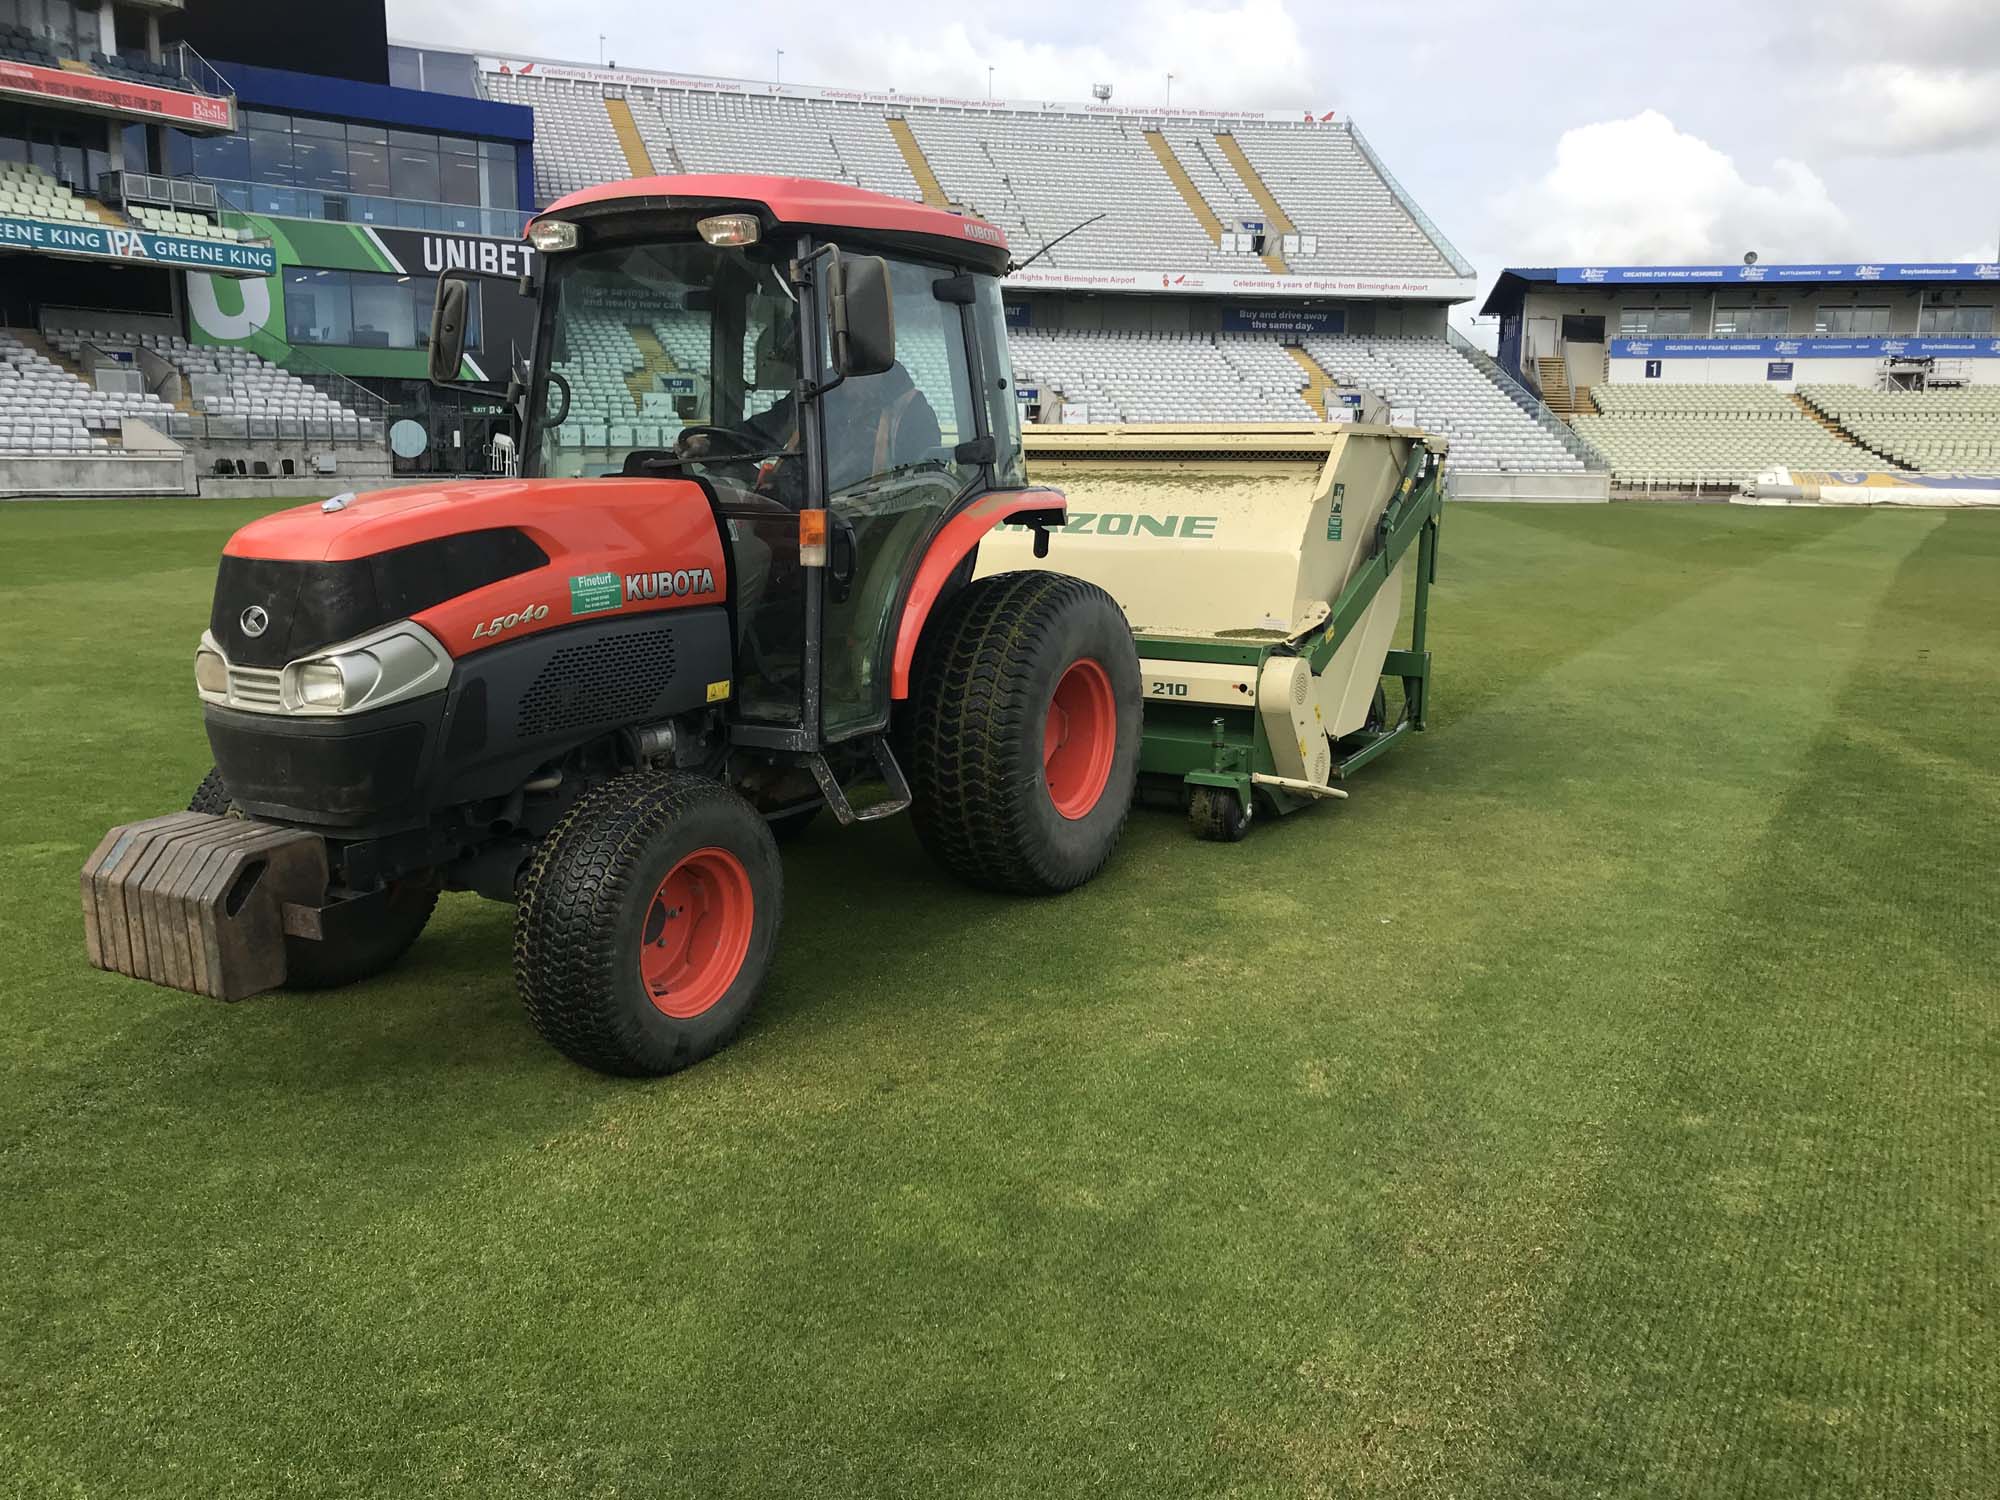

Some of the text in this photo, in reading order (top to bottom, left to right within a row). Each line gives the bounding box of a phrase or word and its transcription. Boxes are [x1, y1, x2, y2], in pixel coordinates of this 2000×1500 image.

[541, 66, 586, 80] Celebrating
[594, 73, 614, 83] years
[616, 73, 625, 82] of
[626, 74, 648, 84] flights
[650, 76, 668, 85] from
[669, 78, 714, 90] Birmingham
[715, 82, 741, 93] Airport
[820, 89, 861, 101] Celebrating
[869, 94, 889, 103] years
[890, 93, 898, 101] of
[899, 94, 921, 104] flights
[922, 95, 939, 103] from
[940, 97, 981, 108] Birmingham
[982, 100, 1006, 109] Airport
[192, 101, 227, 121] Basils
[1084, 104, 1124, 116] Celebrating
[1131, 108, 1149, 117] years
[1150, 107, 1158, 115] of
[1159, 108, 1180, 118] flights
[1182, 108, 1198, 117] from
[1199, 109, 1240, 119] Birmingham
[1241, 111, 1264, 120] Airport
[963, 223, 1000, 240] KUBOTA
[50, 228, 101, 249] KING
[106, 230, 149, 258] IPA
[154, 241, 224, 263] GREENE
[229, 249, 272, 267] KING
[423, 236, 536, 277] UNIBET
[1010, 273, 1136, 285] of flights from Birmingham Airport
[1233, 279, 1429, 292] Celebrating 5 years of flights from Birmingham Airport
[1239, 309, 1328, 323] Buy and drive away
[1252, 320, 1314, 332] the same day.
[1650, 362, 1657, 377] 1
[577, 572, 612, 589] Fineturf
[625, 568, 716, 601] KUBOTA
[471, 604, 549, 640] L5040
[1152, 682, 1188, 697] 210
